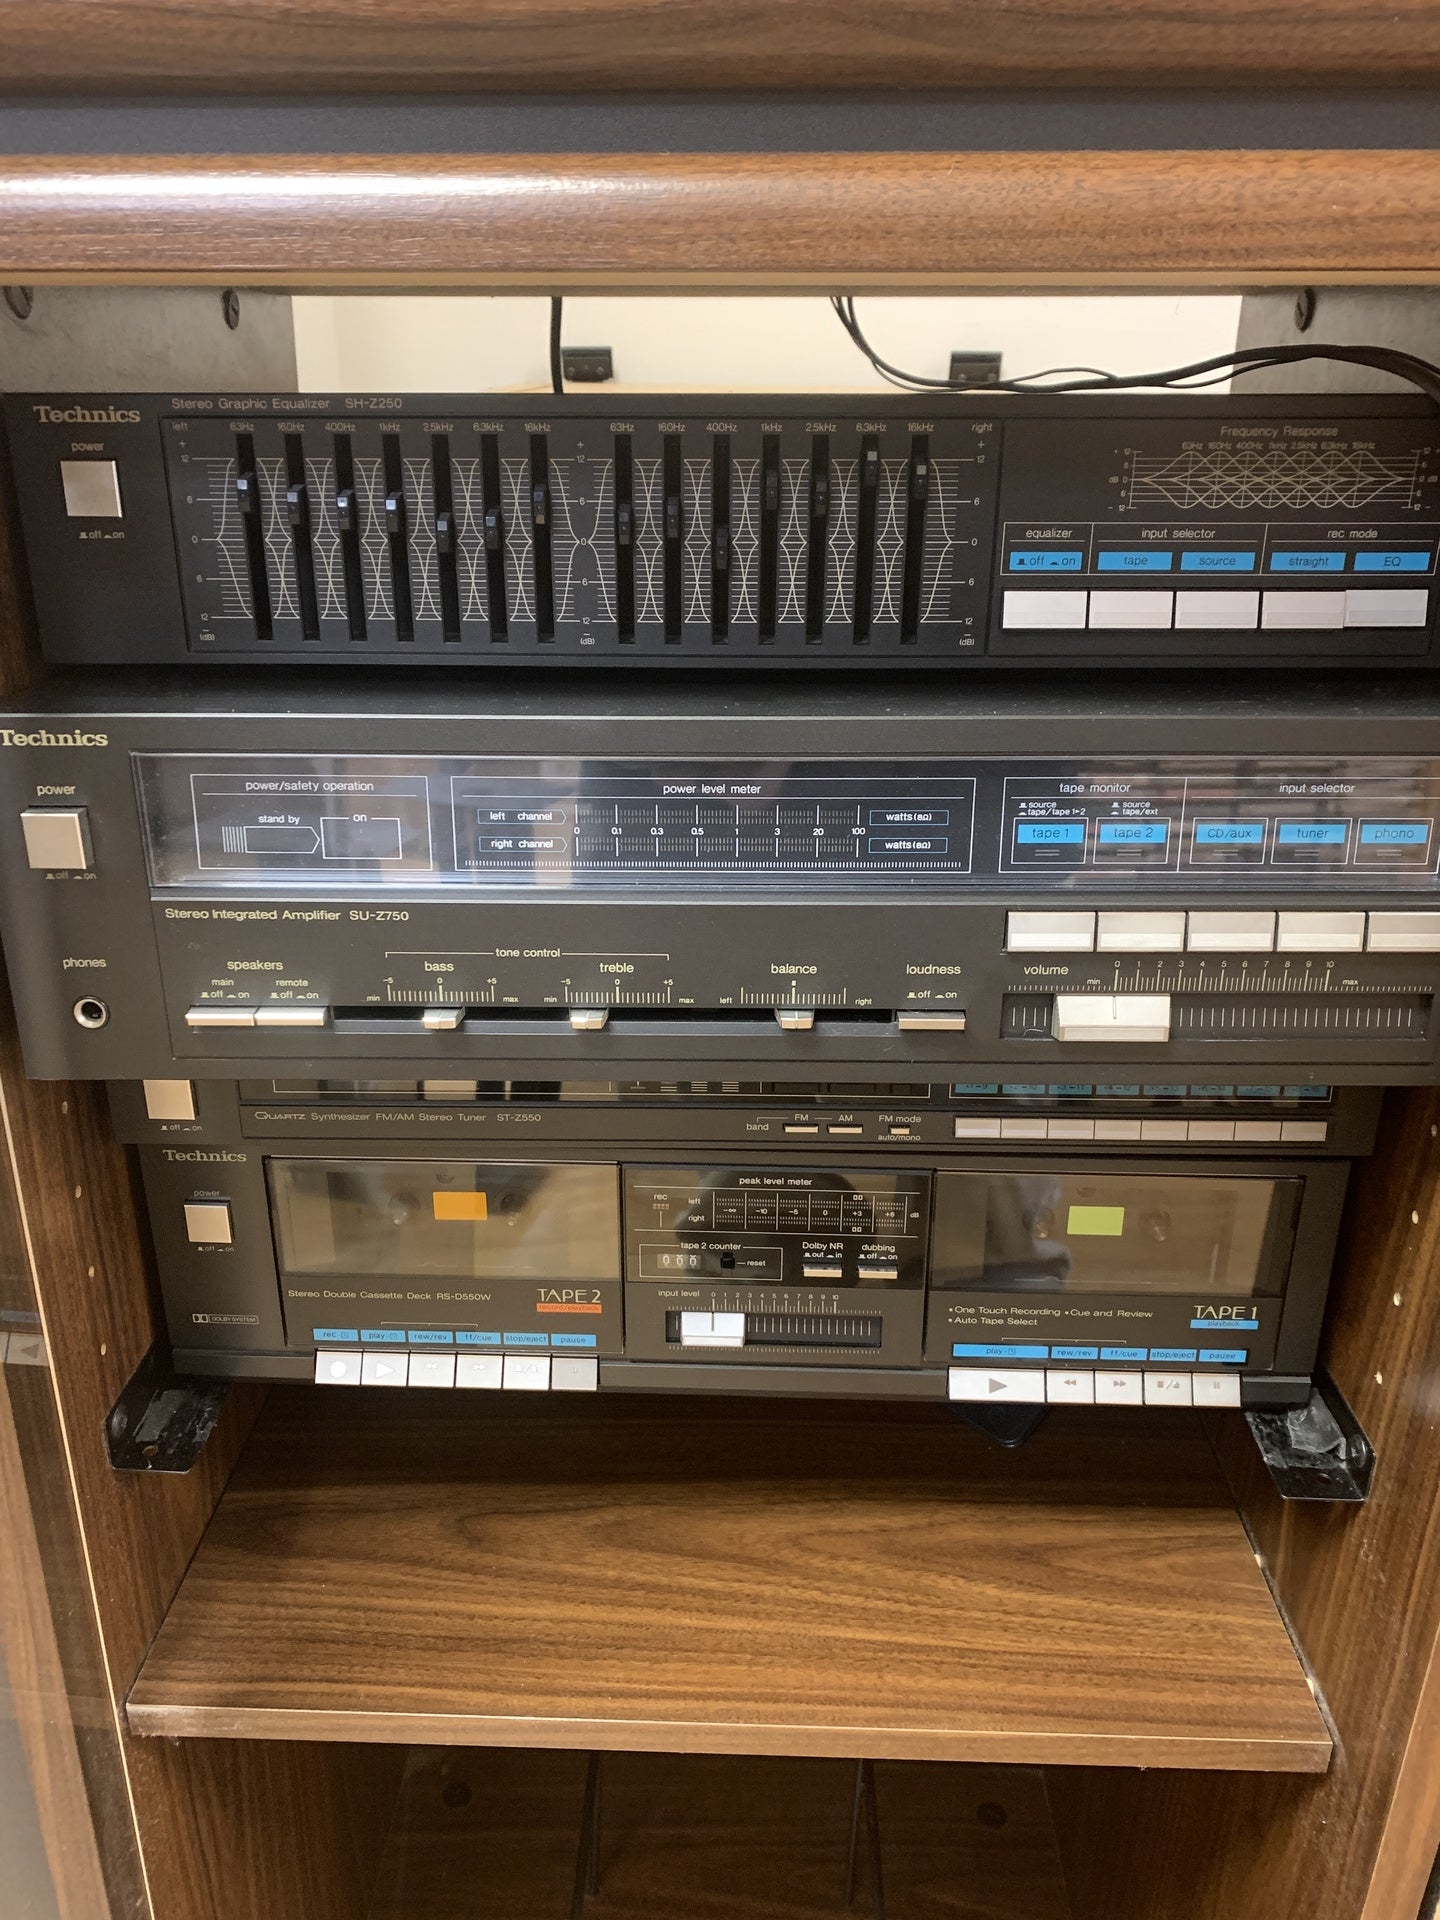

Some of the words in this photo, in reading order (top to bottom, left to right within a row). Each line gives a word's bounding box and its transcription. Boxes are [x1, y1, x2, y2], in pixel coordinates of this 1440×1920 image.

[171, 398, 213, 410] Stereo
[218, 398, 267, 412] Graphic
[272, 398, 330, 411] Equalizer
[345, 398, 402, 410] SH-Z250
[33, 405, 141, 423] Technics
[172, 421, 188, 431] left
[230, 422, 254, 431] 63Hz
[277, 422, 304, 431] 160Hz
[325, 422, 355, 432] 400Hz
[379, 422, 400, 432] 1kHz
[423, 422, 454, 432] 2.5kHz
[473, 422, 504, 432] 6.3kHz
[524, 422, 551, 432] 16kHz
[610, 422, 635, 432] 63Hz
[658, 422, 685, 432] 160Hz
[706, 422, 737, 432] 400Hz
[761, 422, 782, 432] 1kHz
[805, 422, 837, 432] 2.5kHz
[856, 422, 887, 432] 6.3kHz
[907, 422, 934, 432] 16kHz
[971, 422, 993, 434] right
[1220, 426, 1278, 438] Frequency
[1283, 426, 1339, 438] Response
[71, 442, 104, 453] power
[1026, 527, 1072, 539] equalizer
[1141, 528, 1168, 539] input
[1173, 527, 1216, 539] selector
[1327, 530, 1345, 539] rec
[1350, 528, 1378, 539] mode
[1029, 556, 1044, 566] off
[1062, 558, 1076, 566] on
[1124, 556, 1148, 567] tape
[1199, 557, 1236, 566] source
[1289, 555, 1329, 568] straight
[1384, 557, 1401, 567] EQ
[0, 729, 109, 747] Technics
[37, 785, 76, 796] power
[245, 780, 320, 793] power/safety
[323, 780, 374, 793] operation
[663, 784, 697, 795] power
[701, 784, 726, 794] level
[730, 785, 761, 794] meter
[1059, 783, 1084, 794] tape
[1089, 783, 1131, 793] monitor
[1279, 783, 1306, 794] input
[1310, 783, 1356, 794] selector
[1028, 801, 1057, 809] source
[490, 811, 506, 821] left
[517, 811, 552, 821] channel
[1027, 808, 1070, 816] tape/tape
[1122, 808, 1159, 816] tape/ext
[258, 814, 284, 823] stand
[287, 814, 300, 825] by
[353, 814, 367, 823] on
[650, 827, 664, 835] 0.3
[691, 827, 704, 835] 0.5
[812, 828, 824, 836] 20
[851, 828, 866, 836] 100
[1032, 828, 1060, 839] tape
[1114, 828, 1141, 839] tape
[1145, 828, 1154, 838] 2
[1207, 828, 1252, 839] CD/aux
[1297, 828, 1329, 839] tuner
[1374, 828, 1415, 841] phono
[491, 839, 513, 850] right
[518, 839, 553, 848] channel
[165, 908, 209, 920] Stereo
[212, 909, 278, 922] Integrated
[282, 910, 341, 922] Amplifier
[349, 911, 410, 922] SU-Z750
[495, 949, 520, 957] tone
[523, 948, 561, 957] control
[63, 957, 107, 970] phones
[227, 959, 283, 971] speakers
[424, 961, 454, 972] bass
[599, 962, 634, 973] treble
[771, 963, 817, 975] balance
[906, 963, 961, 975] loudness
[1023, 964, 1069, 976] volume
[211, 978, 234, 987] main
[276, 978, 309, 987] remote
[280, 990, 293, 999] off
[306, 991, 319, 999] on
[855, 998, 872, 1006] right
[311, 1112, 370, 1123] Synthesizer
[375, 1113, 414, 1121] FM/AM
[418, 1113, 453, 1121] Stereo
[458, 1113, 486, 1122] Tuner
[496, 1113, 542, 1122] ST-Z550
[794, 1114, 809, 1122] FM
[838, 1114, 853, 1122] AM
[878, 1115, 893, 1123] FM
[895, 1115, 922, 1123] mode
[746, 1123, 769, 1131] band
[877, 1134, 921, 1142] auto/mono
[163, 1149, 247, 1162] Technics
[739, 1177, 761, 1186] peak
[763, 1177, 784, 1185] level
[787, 1178, 813, 1186] meter
[194, 1190, 220, 1198] power
[653, 1193, 668, 1201] rec
[688, 1214, 705, 1223] right
[680, 1241, 699, 1250] tape
[709, 1242, 742, 1250] counter
[802, 1241, 828, 1251] Dolby
[829, 1242, 844, 1250] NR
[861, 1244, 896, 1252] dubbing
[288, 1289, 320, 1298] Stereo
[323, 1290, 356, 1299] Double
[360, 1291, 403, 1300] Cassette
[407, 1292, 432, 1300] Deck
[436, 1292, 492, 1301] RS-D550W
[537, 1288, 587, 1303] TAPE
[591, 1289, 601, 1304] 2
[658, 1289, 679, 1298] input
[680, 1289, 700, 1297] level
[954, 1305, 976, 1315] One
[978, 1306, 1008, 1315] Touch
[1010, 1306, 1061, 1317] Recording
[1070, 1308, 1091, 1318] Cue
[1093, 1309, 1115, 1317] and
[1117, 1309, 1154, 1319] Review
[1193, 1305, 1246, 1319] TAPE
[1250, 1305, 1258, 1319] 1
[954, 1316, 978, 1325] Auto
[980, 1317, 1004, 1327] Tape
[1007, 1317, 1038, 1326] Select
[1207, 1320, 1240, 1328] playback
[368, 1332, 385, 1340] play
[464, 1333, 492, 1342] ff/cue
[505, 1335, 547, 1343] stop/eject
[560, 1336, 586, 1344] pause
[986, 1347, 1002, 1356] play
[1057, 1349, 1093, 1357] rew/rev
[1109, 1350, 1138, 1358] ff/cue
[1151, 1350, 1195, 1360] stop/eject
[1209, 1352, 1236, 1361] pause
